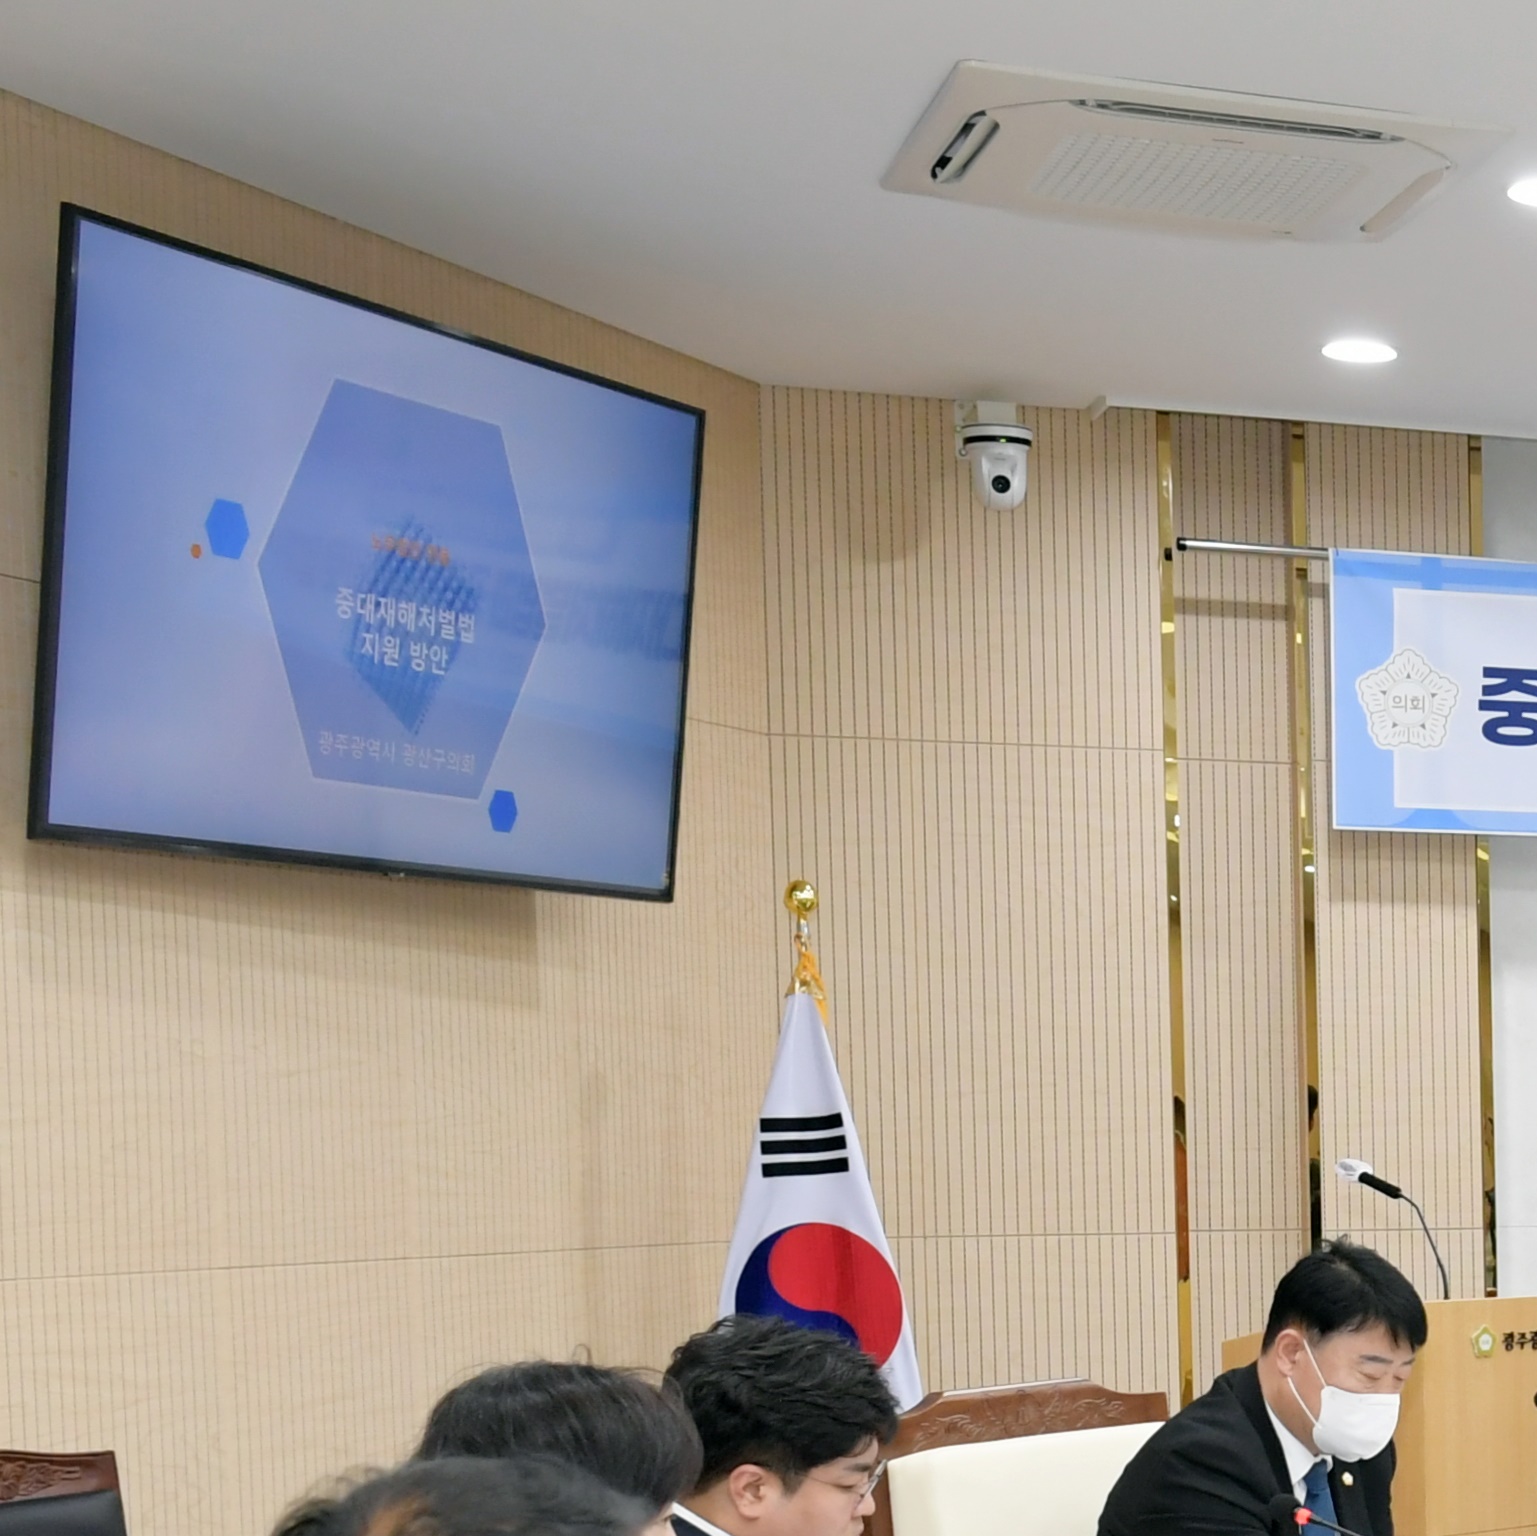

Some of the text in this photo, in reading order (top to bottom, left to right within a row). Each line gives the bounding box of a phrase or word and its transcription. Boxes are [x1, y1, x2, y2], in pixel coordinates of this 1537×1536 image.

[336, 587, 475, 643] 중대재해처벌법
[361, 633, 448, 675] 지원 방안
[1391, 694, 1426, 714] 의회
[318, 731, 475, 775] 광주광역시 광산구의회
